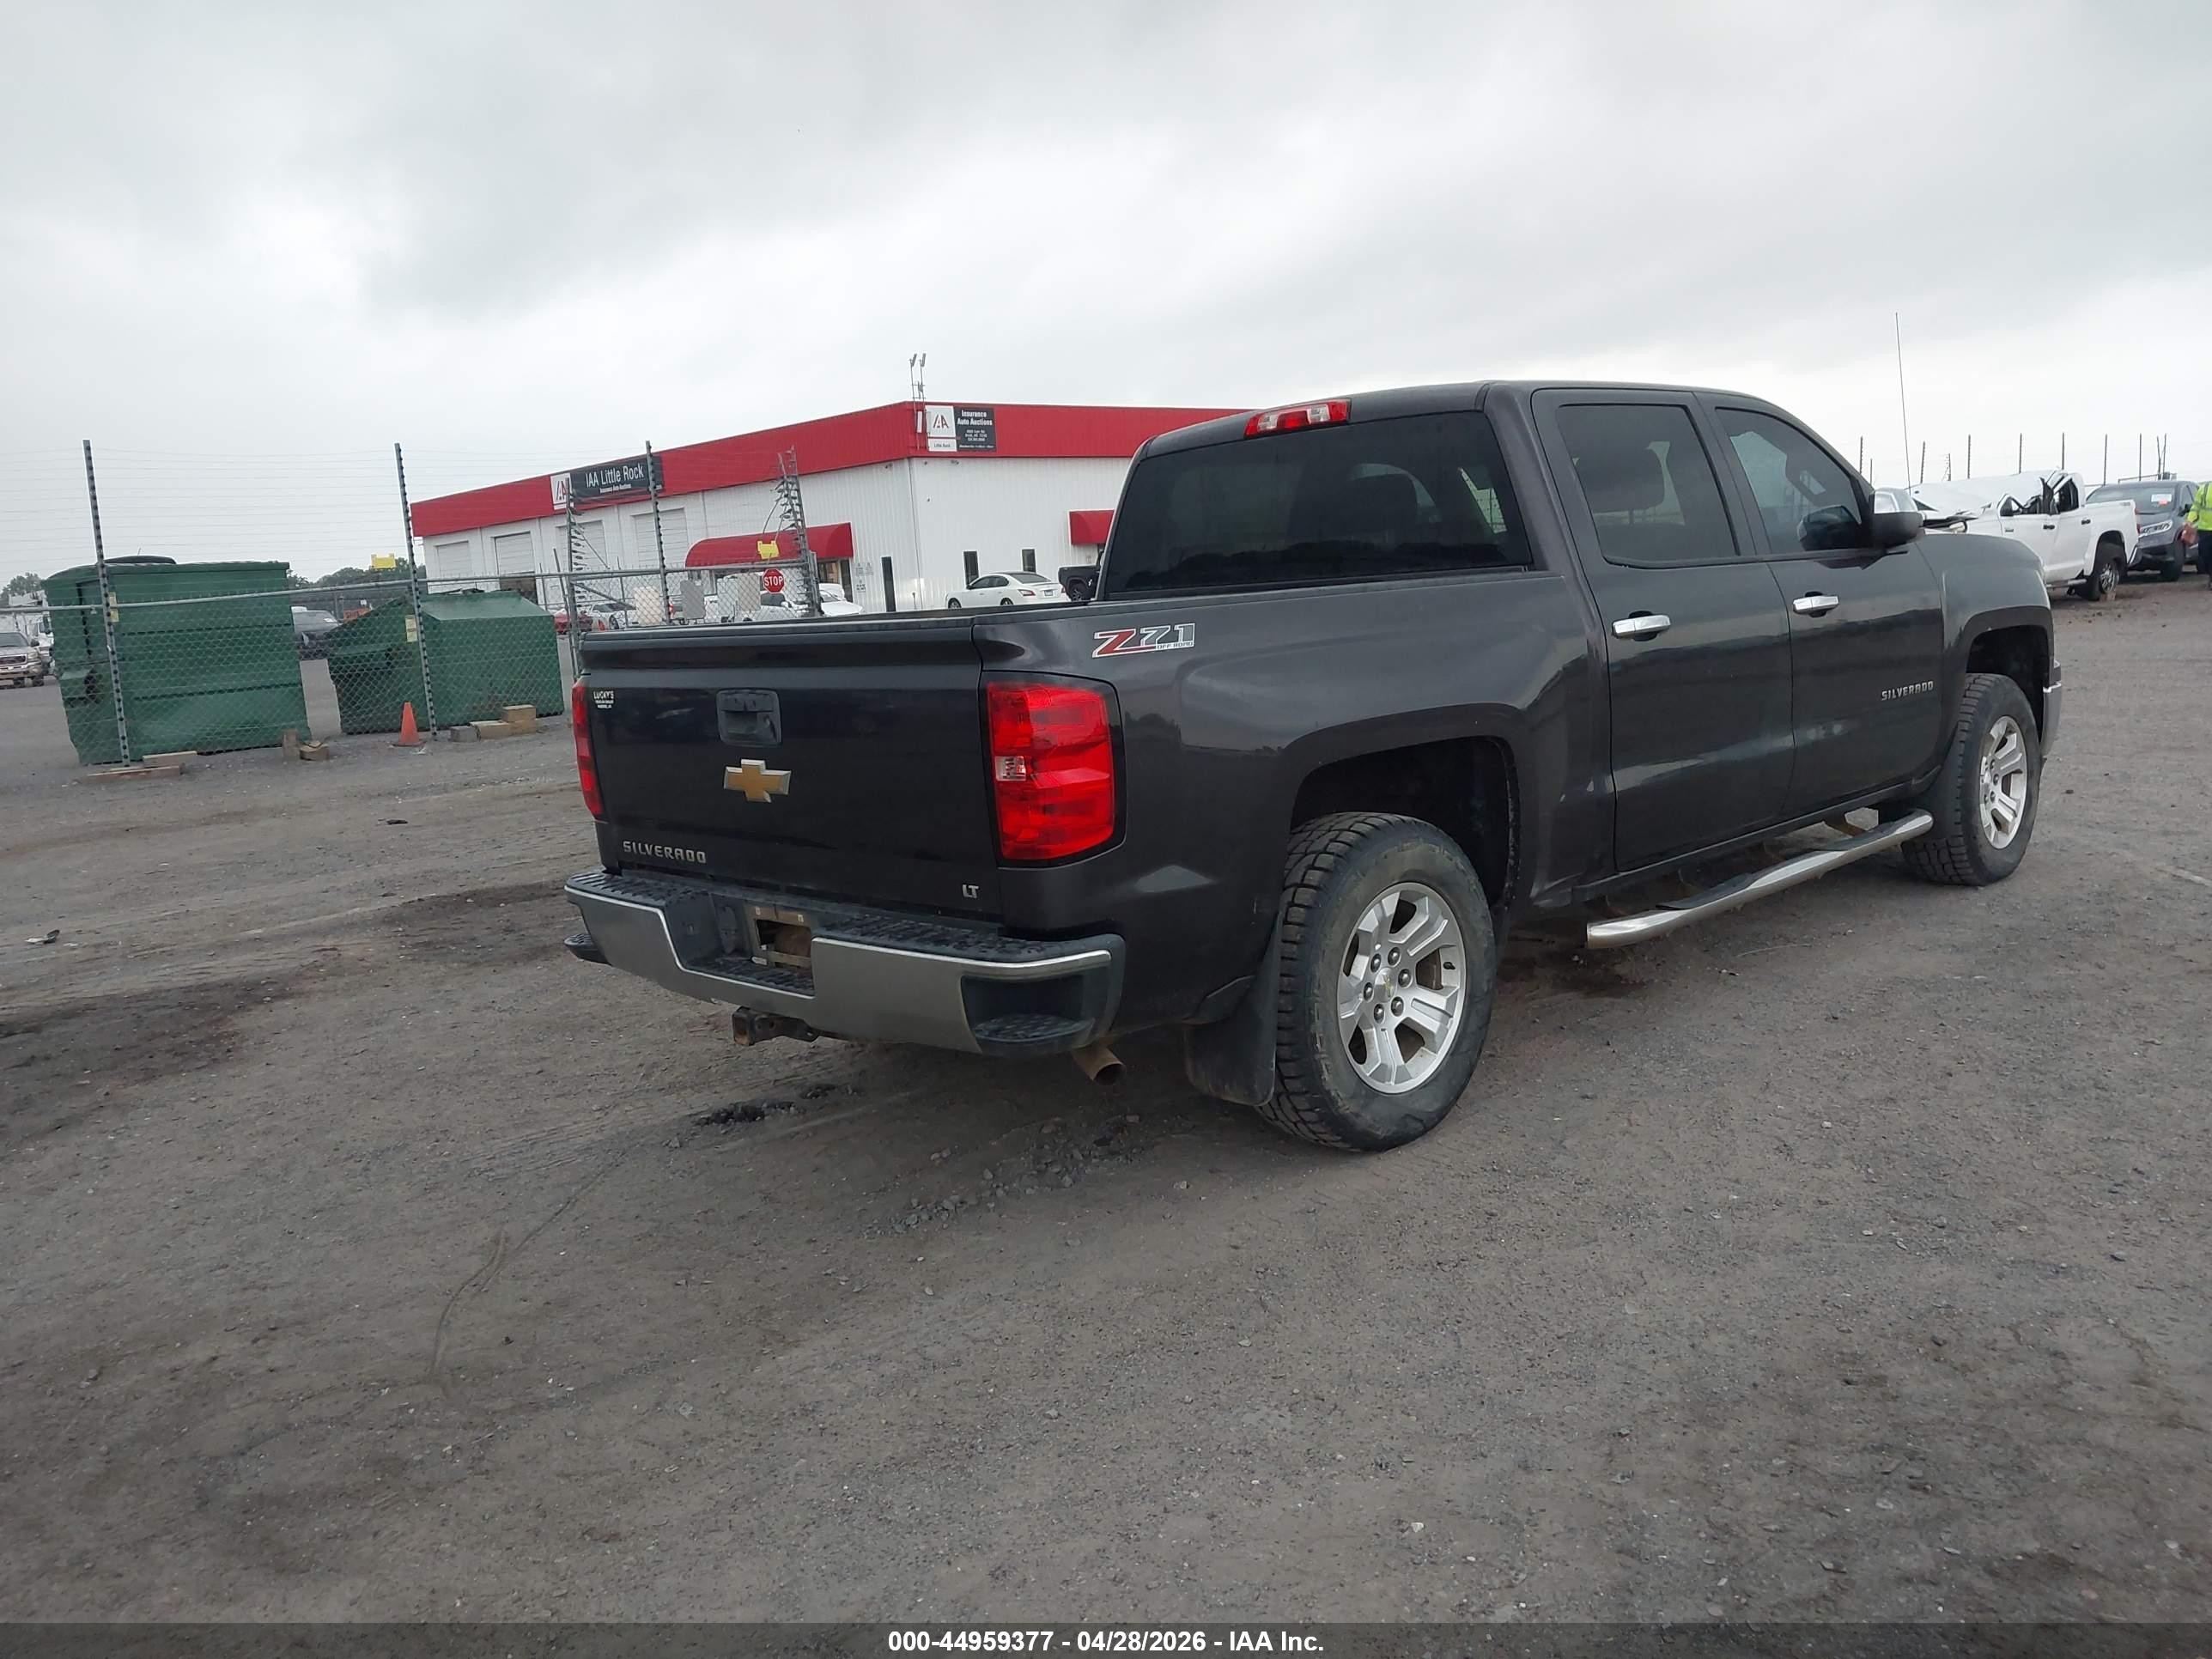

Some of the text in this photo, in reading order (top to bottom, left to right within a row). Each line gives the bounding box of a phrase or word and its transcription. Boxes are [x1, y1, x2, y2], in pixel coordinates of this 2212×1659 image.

[961, 409, 987, 417] Insurance
[969, 417, 993, 426] Auctions
[585, 463, 645, 488] IAA Little Rock
[764, 575, 783, 586] STOP
[1092, 623, 1195, 659] Z71
[1881, 680, 1934, 701] SILVERADO
[623, 841, 707, 864] SILVERADO
[962, 884, 979, 899] LT
